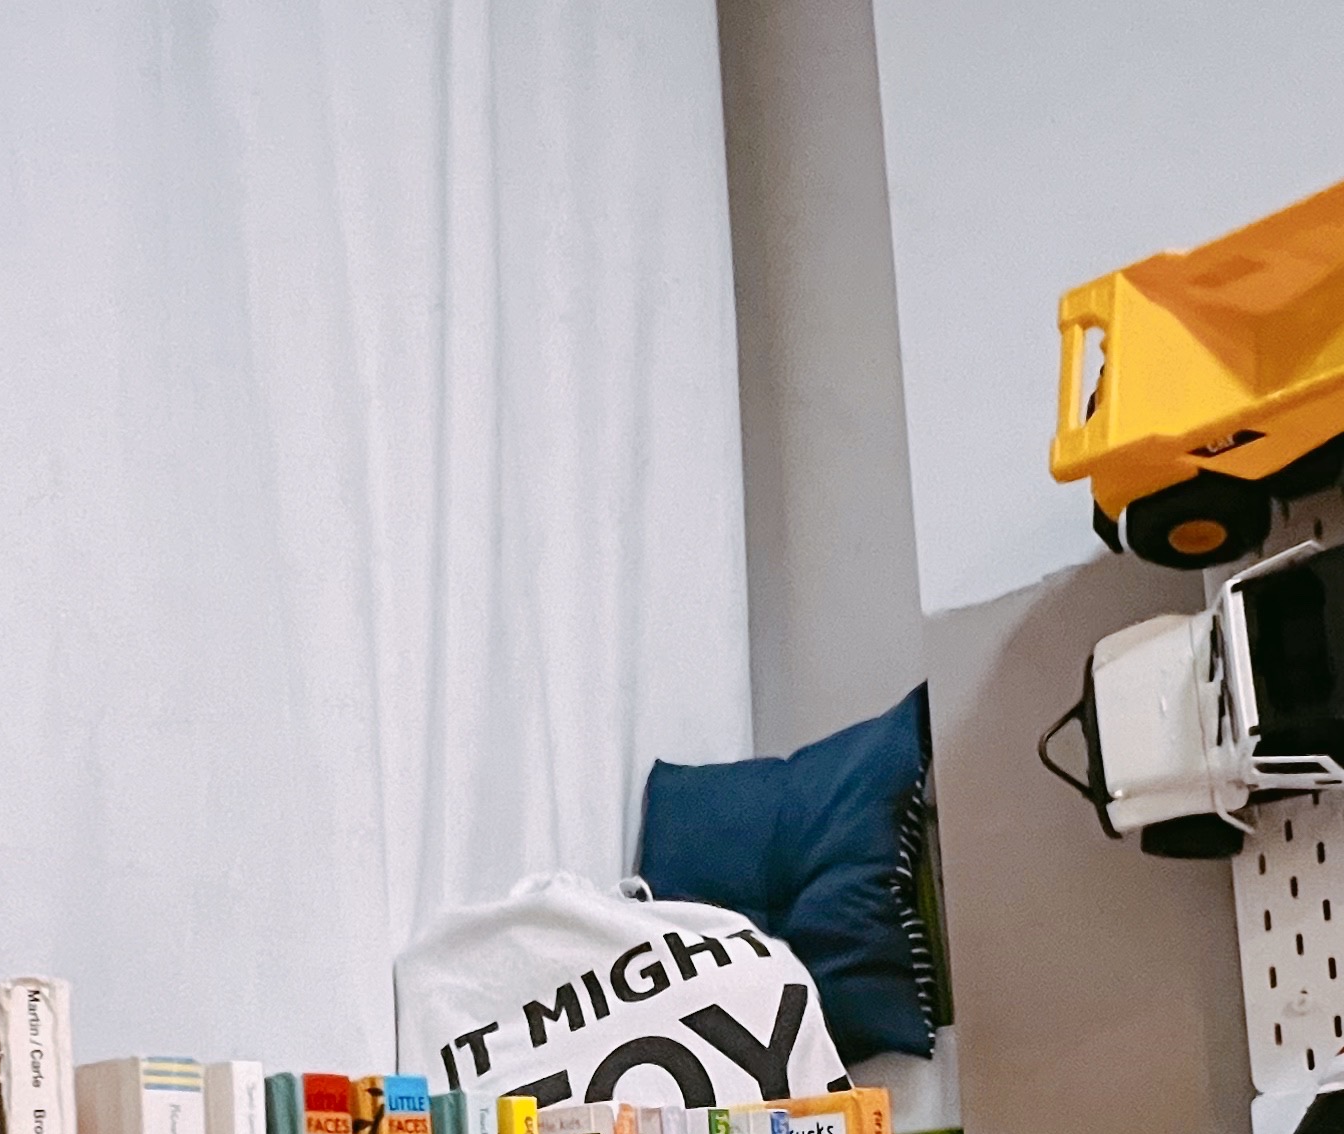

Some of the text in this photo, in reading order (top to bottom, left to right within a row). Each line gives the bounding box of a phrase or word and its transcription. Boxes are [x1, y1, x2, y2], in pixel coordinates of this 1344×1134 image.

[26, 988, 41, 1037] Martin
[440, 928, 771, 1090] IT MIGHT
[30, 1048, 44, 1089] Carle
[306, 1115, 351, 1134] FACES
[388, 1096, 426, 1112] LITTLE
